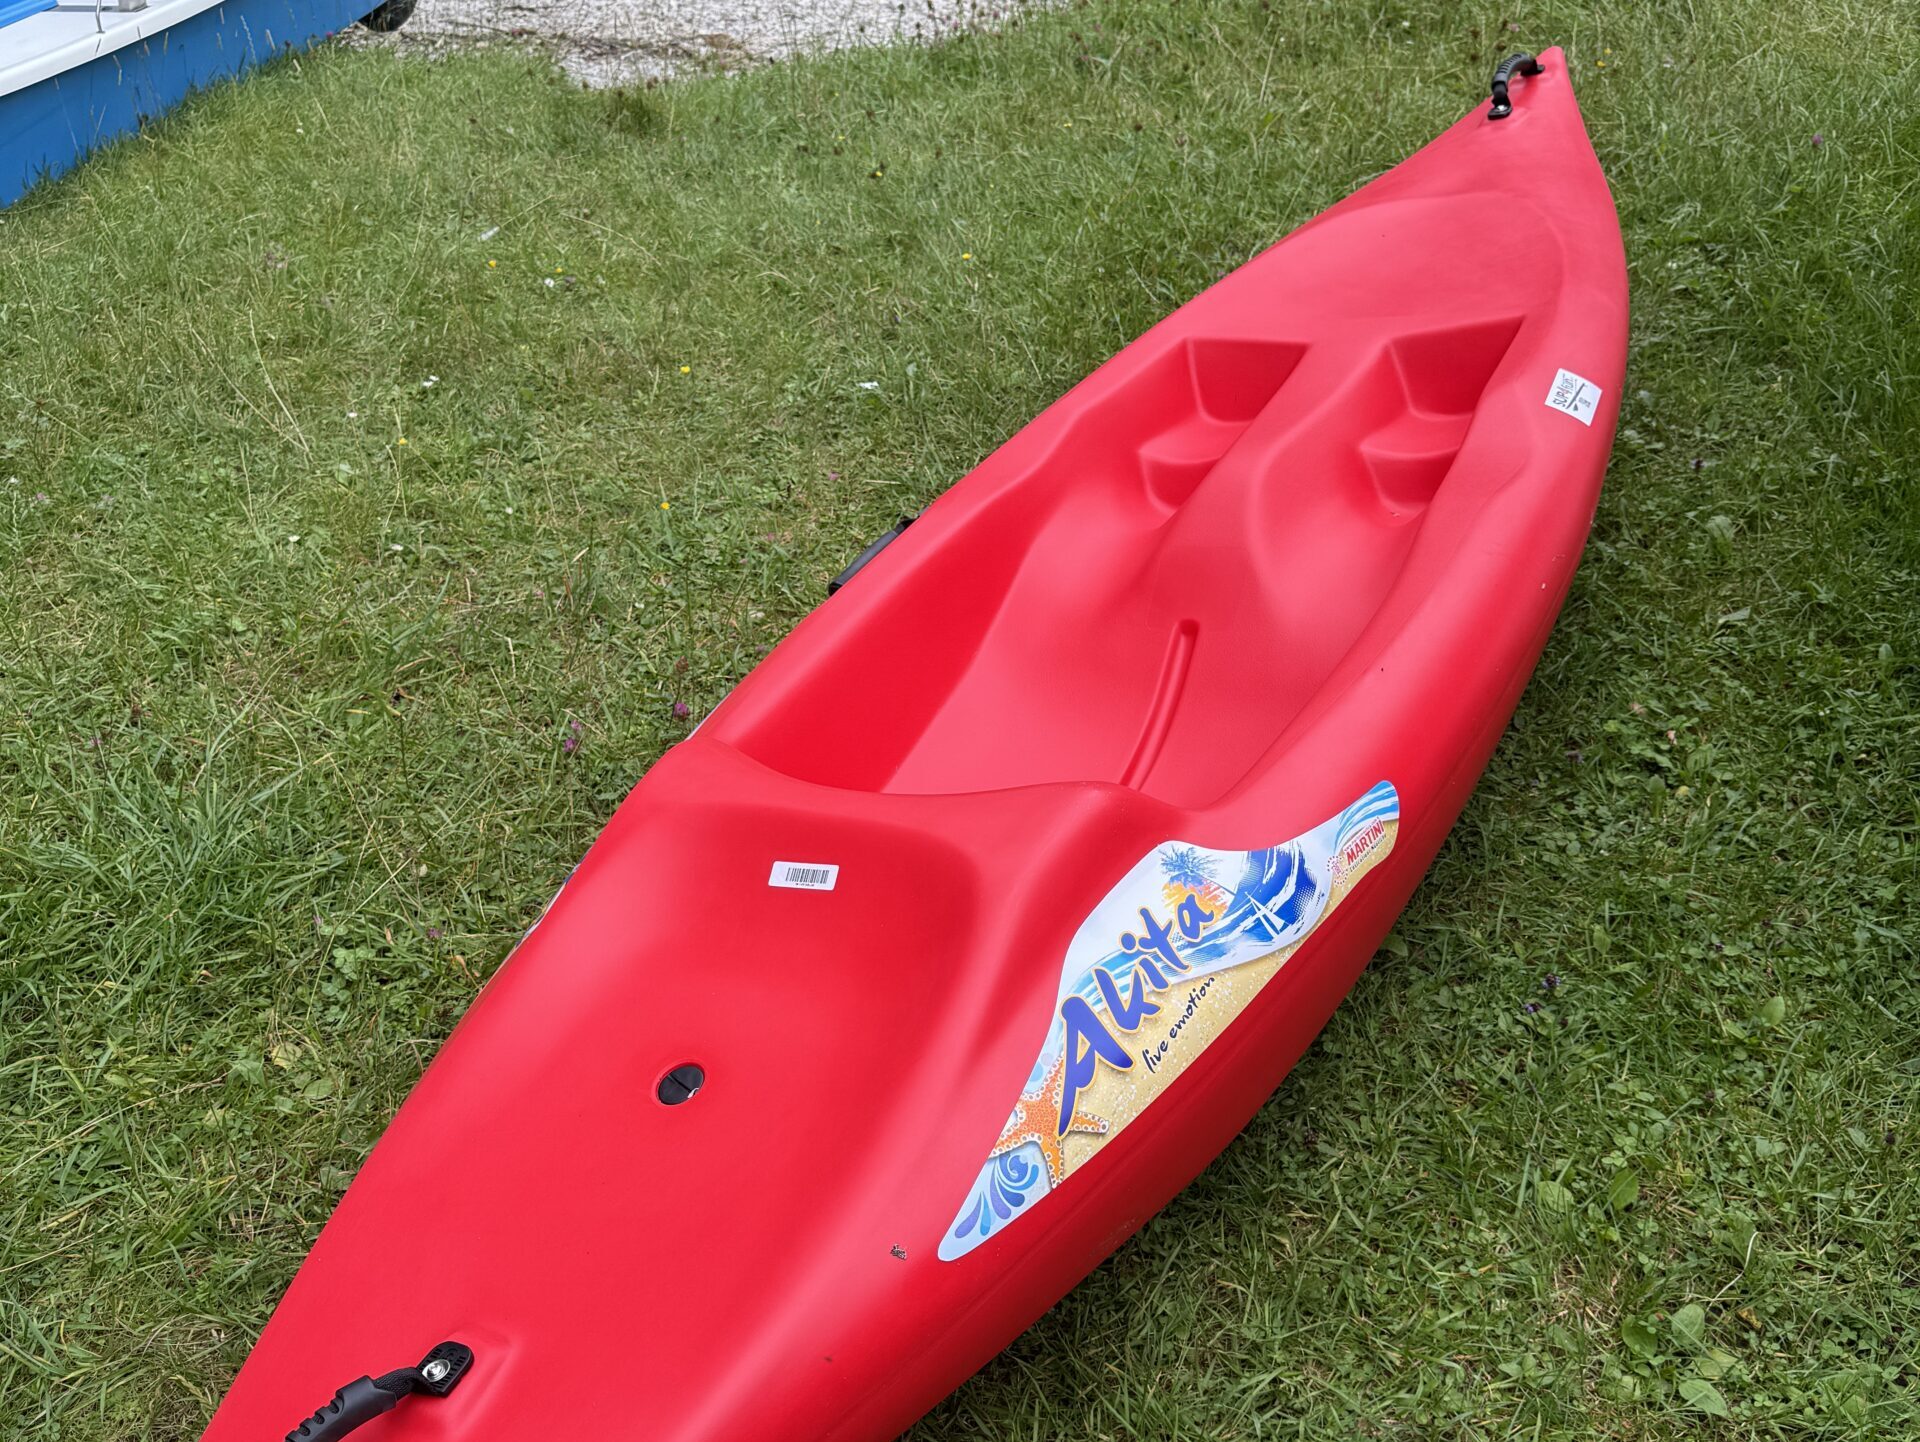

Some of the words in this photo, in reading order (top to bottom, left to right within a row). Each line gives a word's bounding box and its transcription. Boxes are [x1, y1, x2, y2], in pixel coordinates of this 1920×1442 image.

[1346, 820, 1385, 866] MARTINI
[1057, 893, 1215, 1138] Akita
[1141, 1040, 1169, 1074] live
[1169, 976, 1216, 1040] emotion
